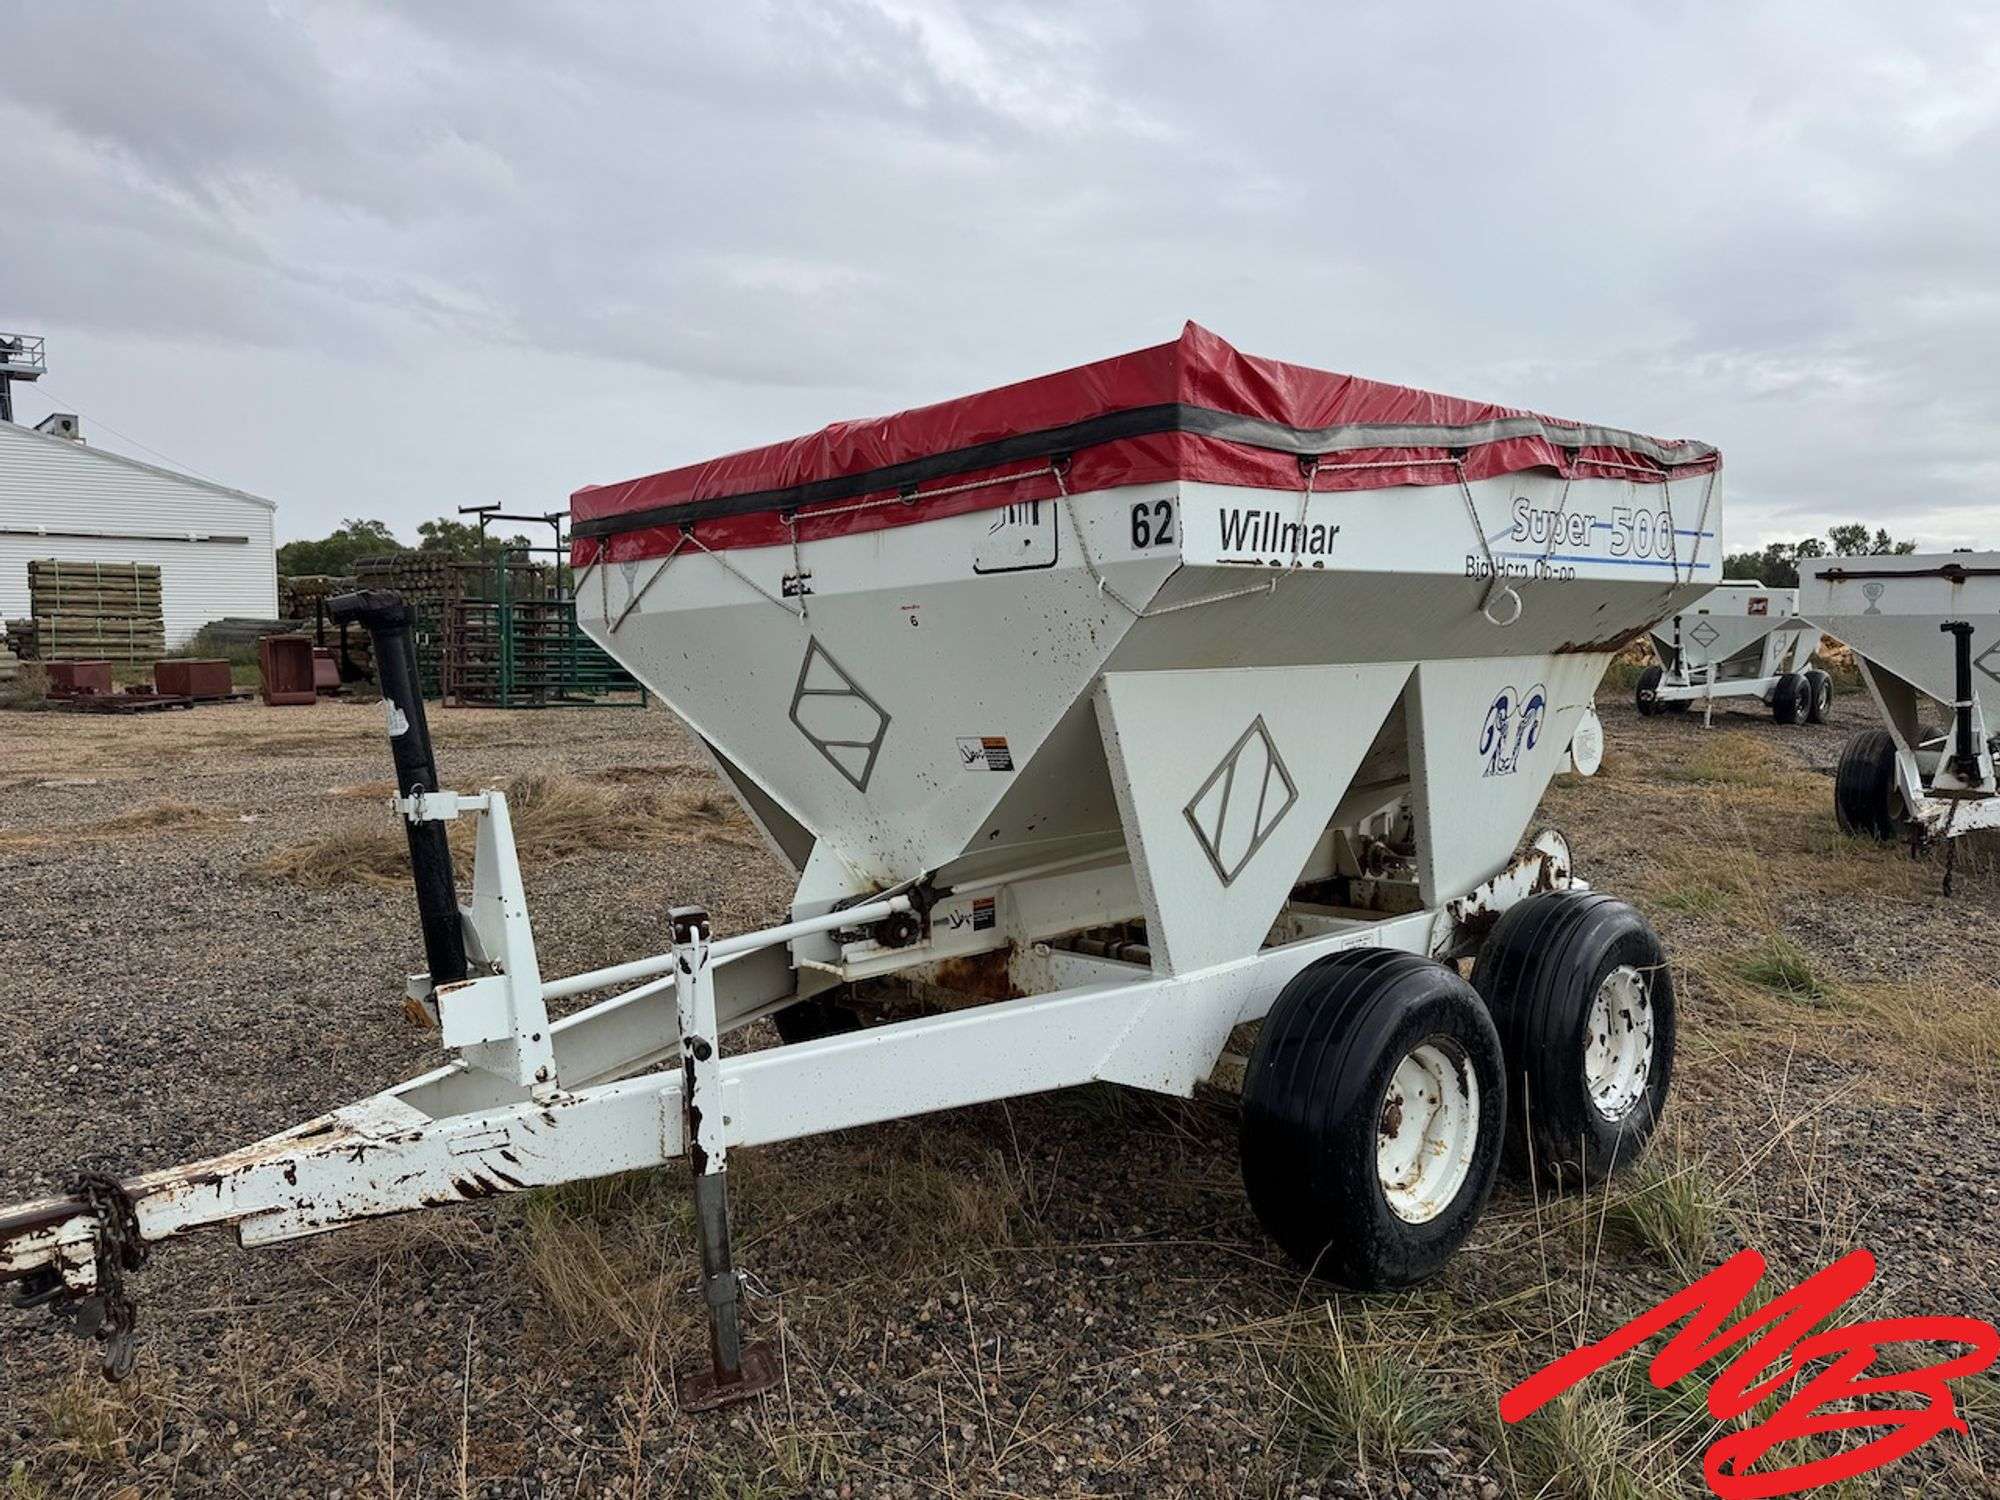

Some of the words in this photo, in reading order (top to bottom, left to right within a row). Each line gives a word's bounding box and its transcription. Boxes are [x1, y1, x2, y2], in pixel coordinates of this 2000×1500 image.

[1132, 500, 1173, 548] 62
[1220, 508, 1340, 555] Willmar
[1511, 497, 1596, 554] Super
[1609, 506, 1675, 560] 500
